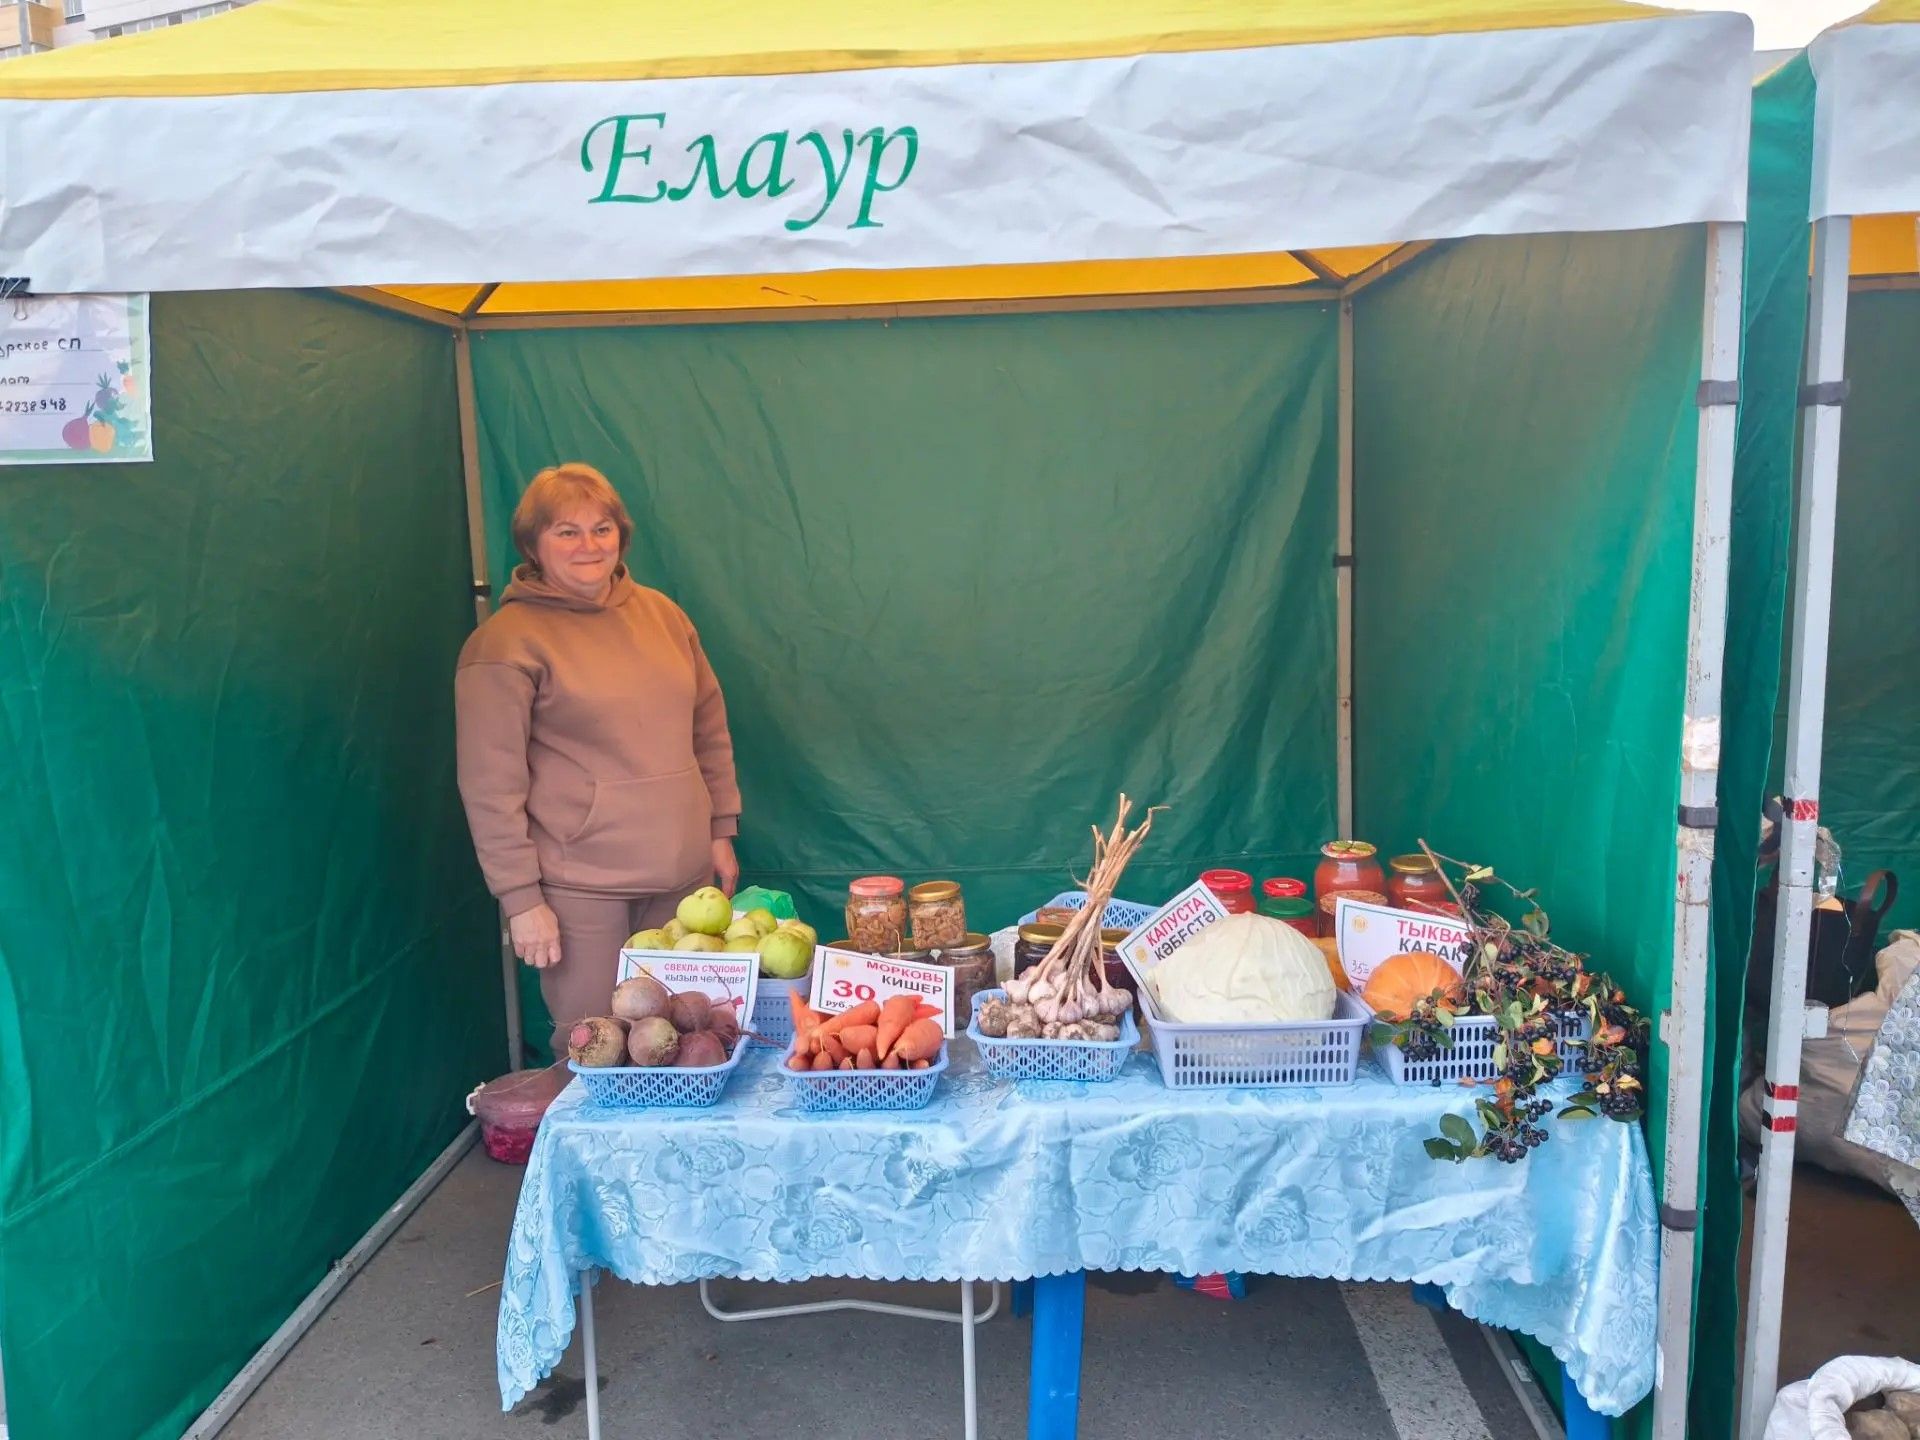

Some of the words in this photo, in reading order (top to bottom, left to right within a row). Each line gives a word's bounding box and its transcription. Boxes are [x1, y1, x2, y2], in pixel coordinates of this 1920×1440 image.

[581, 112, 919, 232] Елаур
[58, 337, 81, 350] СП
[1146, 897, 1206, 946] КАПУСТА
[1397, 920, 1463, 943] ТЫКВА
[664, 963, 699, 972] СВЕКЛА
[702, 965, 747, 973] СТОЛОВАЯ
[866, 960, 944, 983] МОРКОВЬ
[665, 974, 698, 983] КЫЗЫЛ
[881, 975, 943, 995] КИШЕР
[832, 980, 876, 1000] 30
